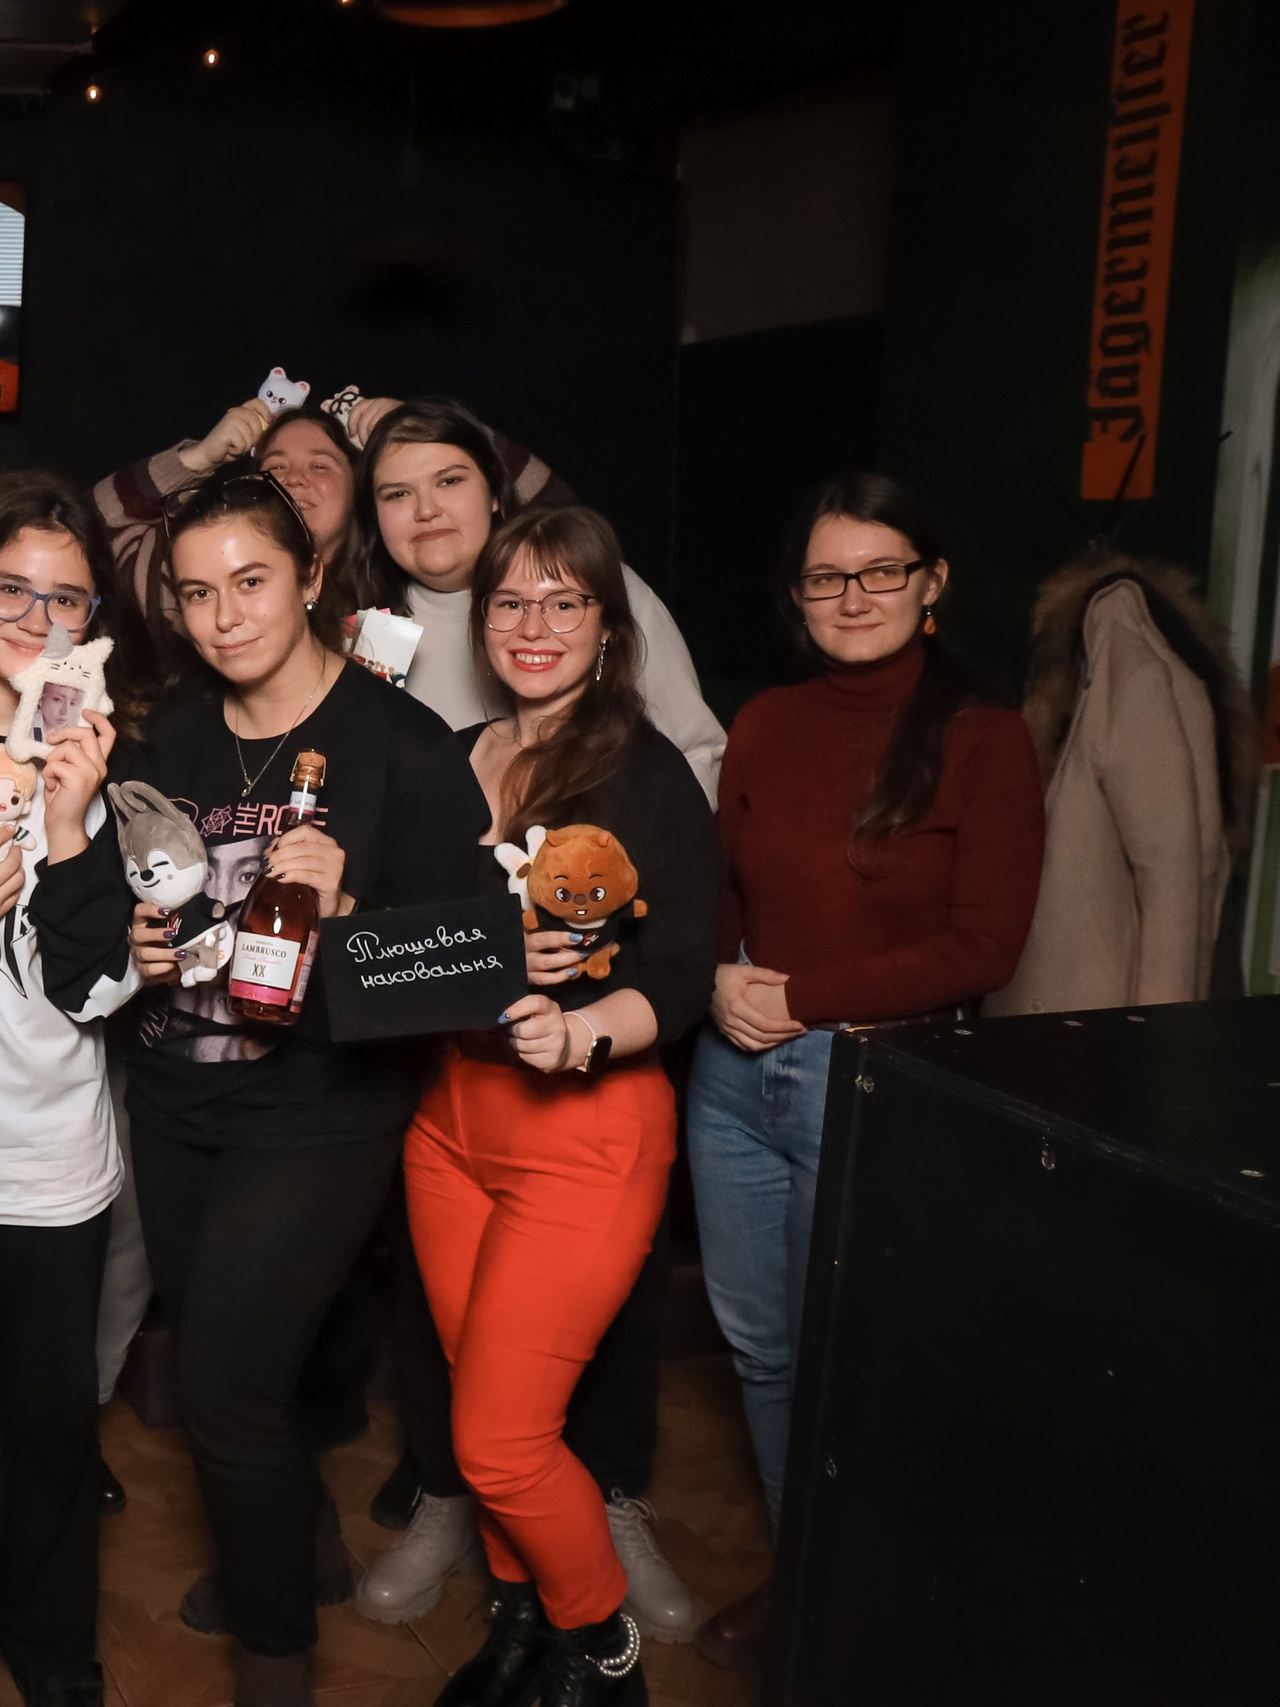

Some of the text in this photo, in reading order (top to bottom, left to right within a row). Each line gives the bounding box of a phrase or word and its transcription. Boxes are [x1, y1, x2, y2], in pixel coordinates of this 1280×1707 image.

[232, 802, 260, 837] THE
[241, 943, 287, 959] LAMBRUSCO
[346, 925, 487, 963] Плюшевая
[251, 963, 266, 978] XX
[360, 955, 504, 989] наковальня
